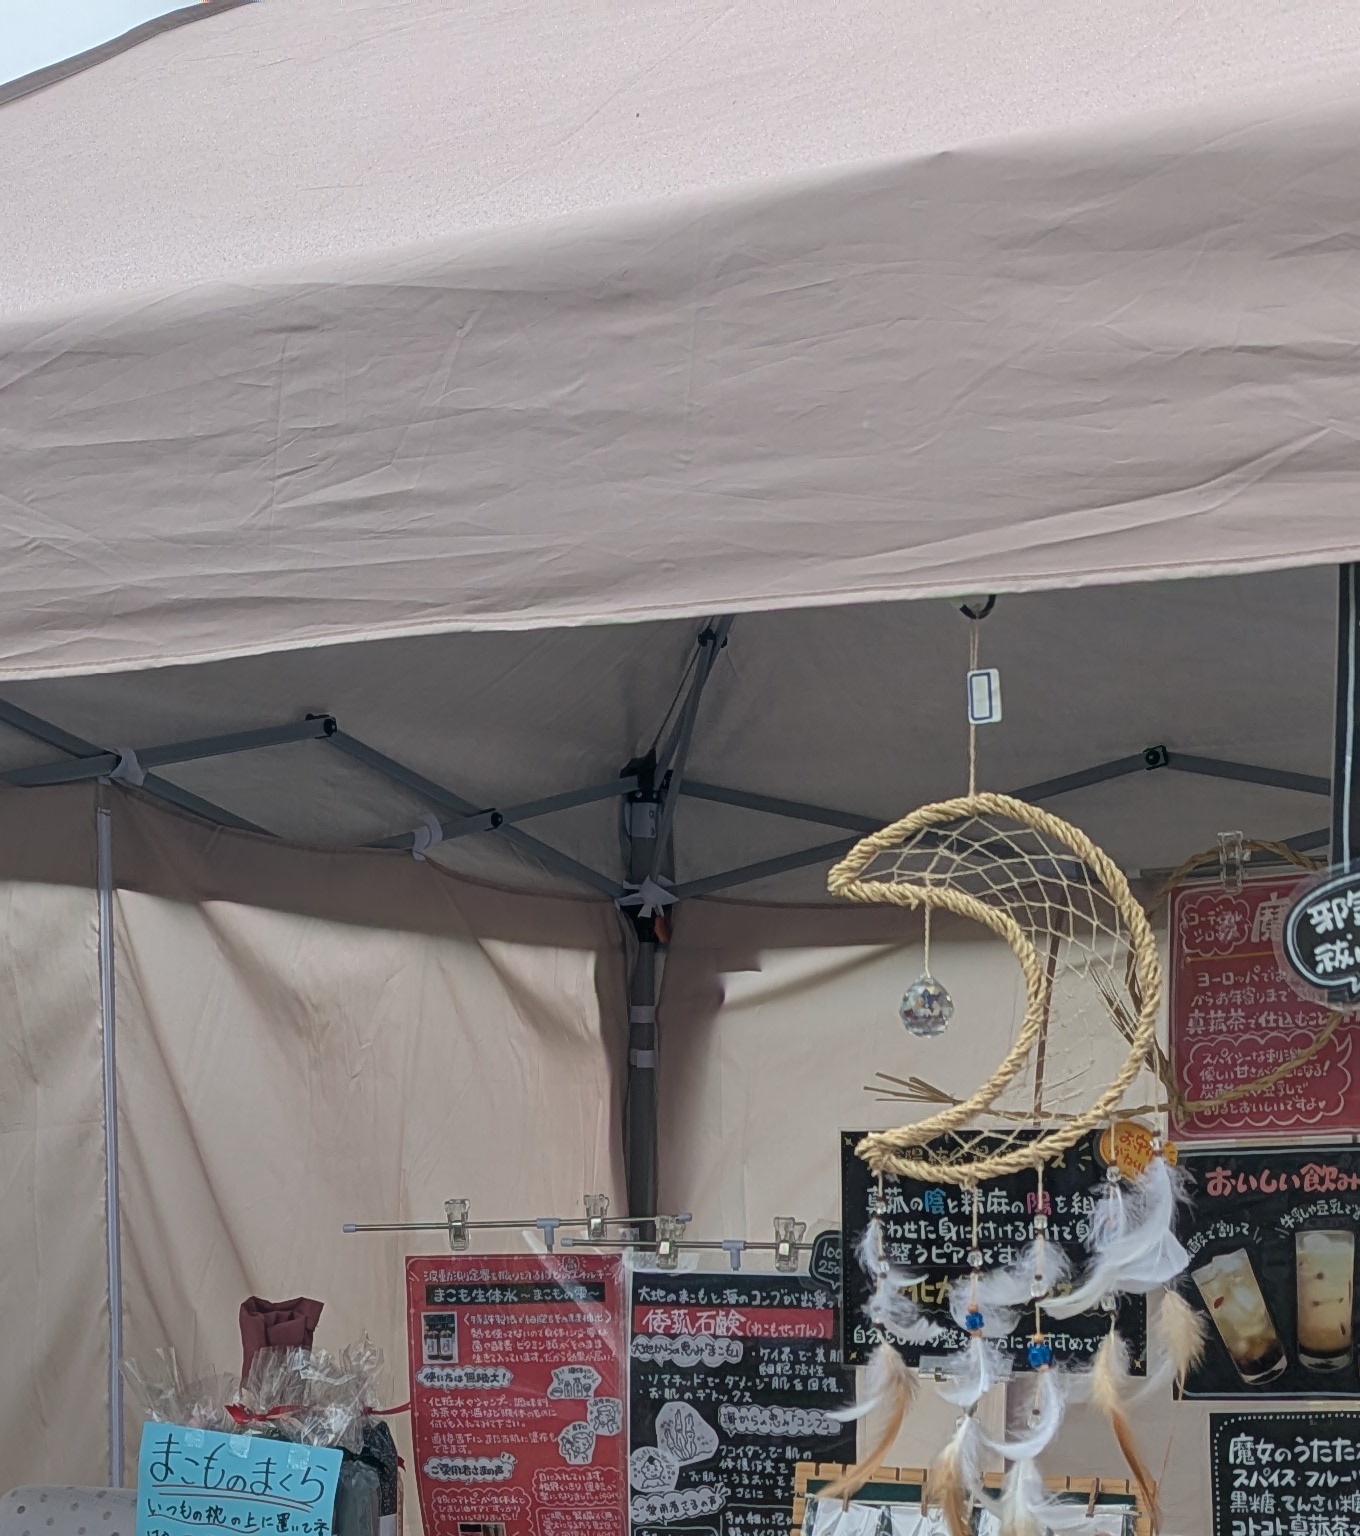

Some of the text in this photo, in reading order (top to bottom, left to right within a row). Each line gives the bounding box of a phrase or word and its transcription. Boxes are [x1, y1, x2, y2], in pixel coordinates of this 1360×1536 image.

[150, 1433, 328, 1504] まこものまくら
